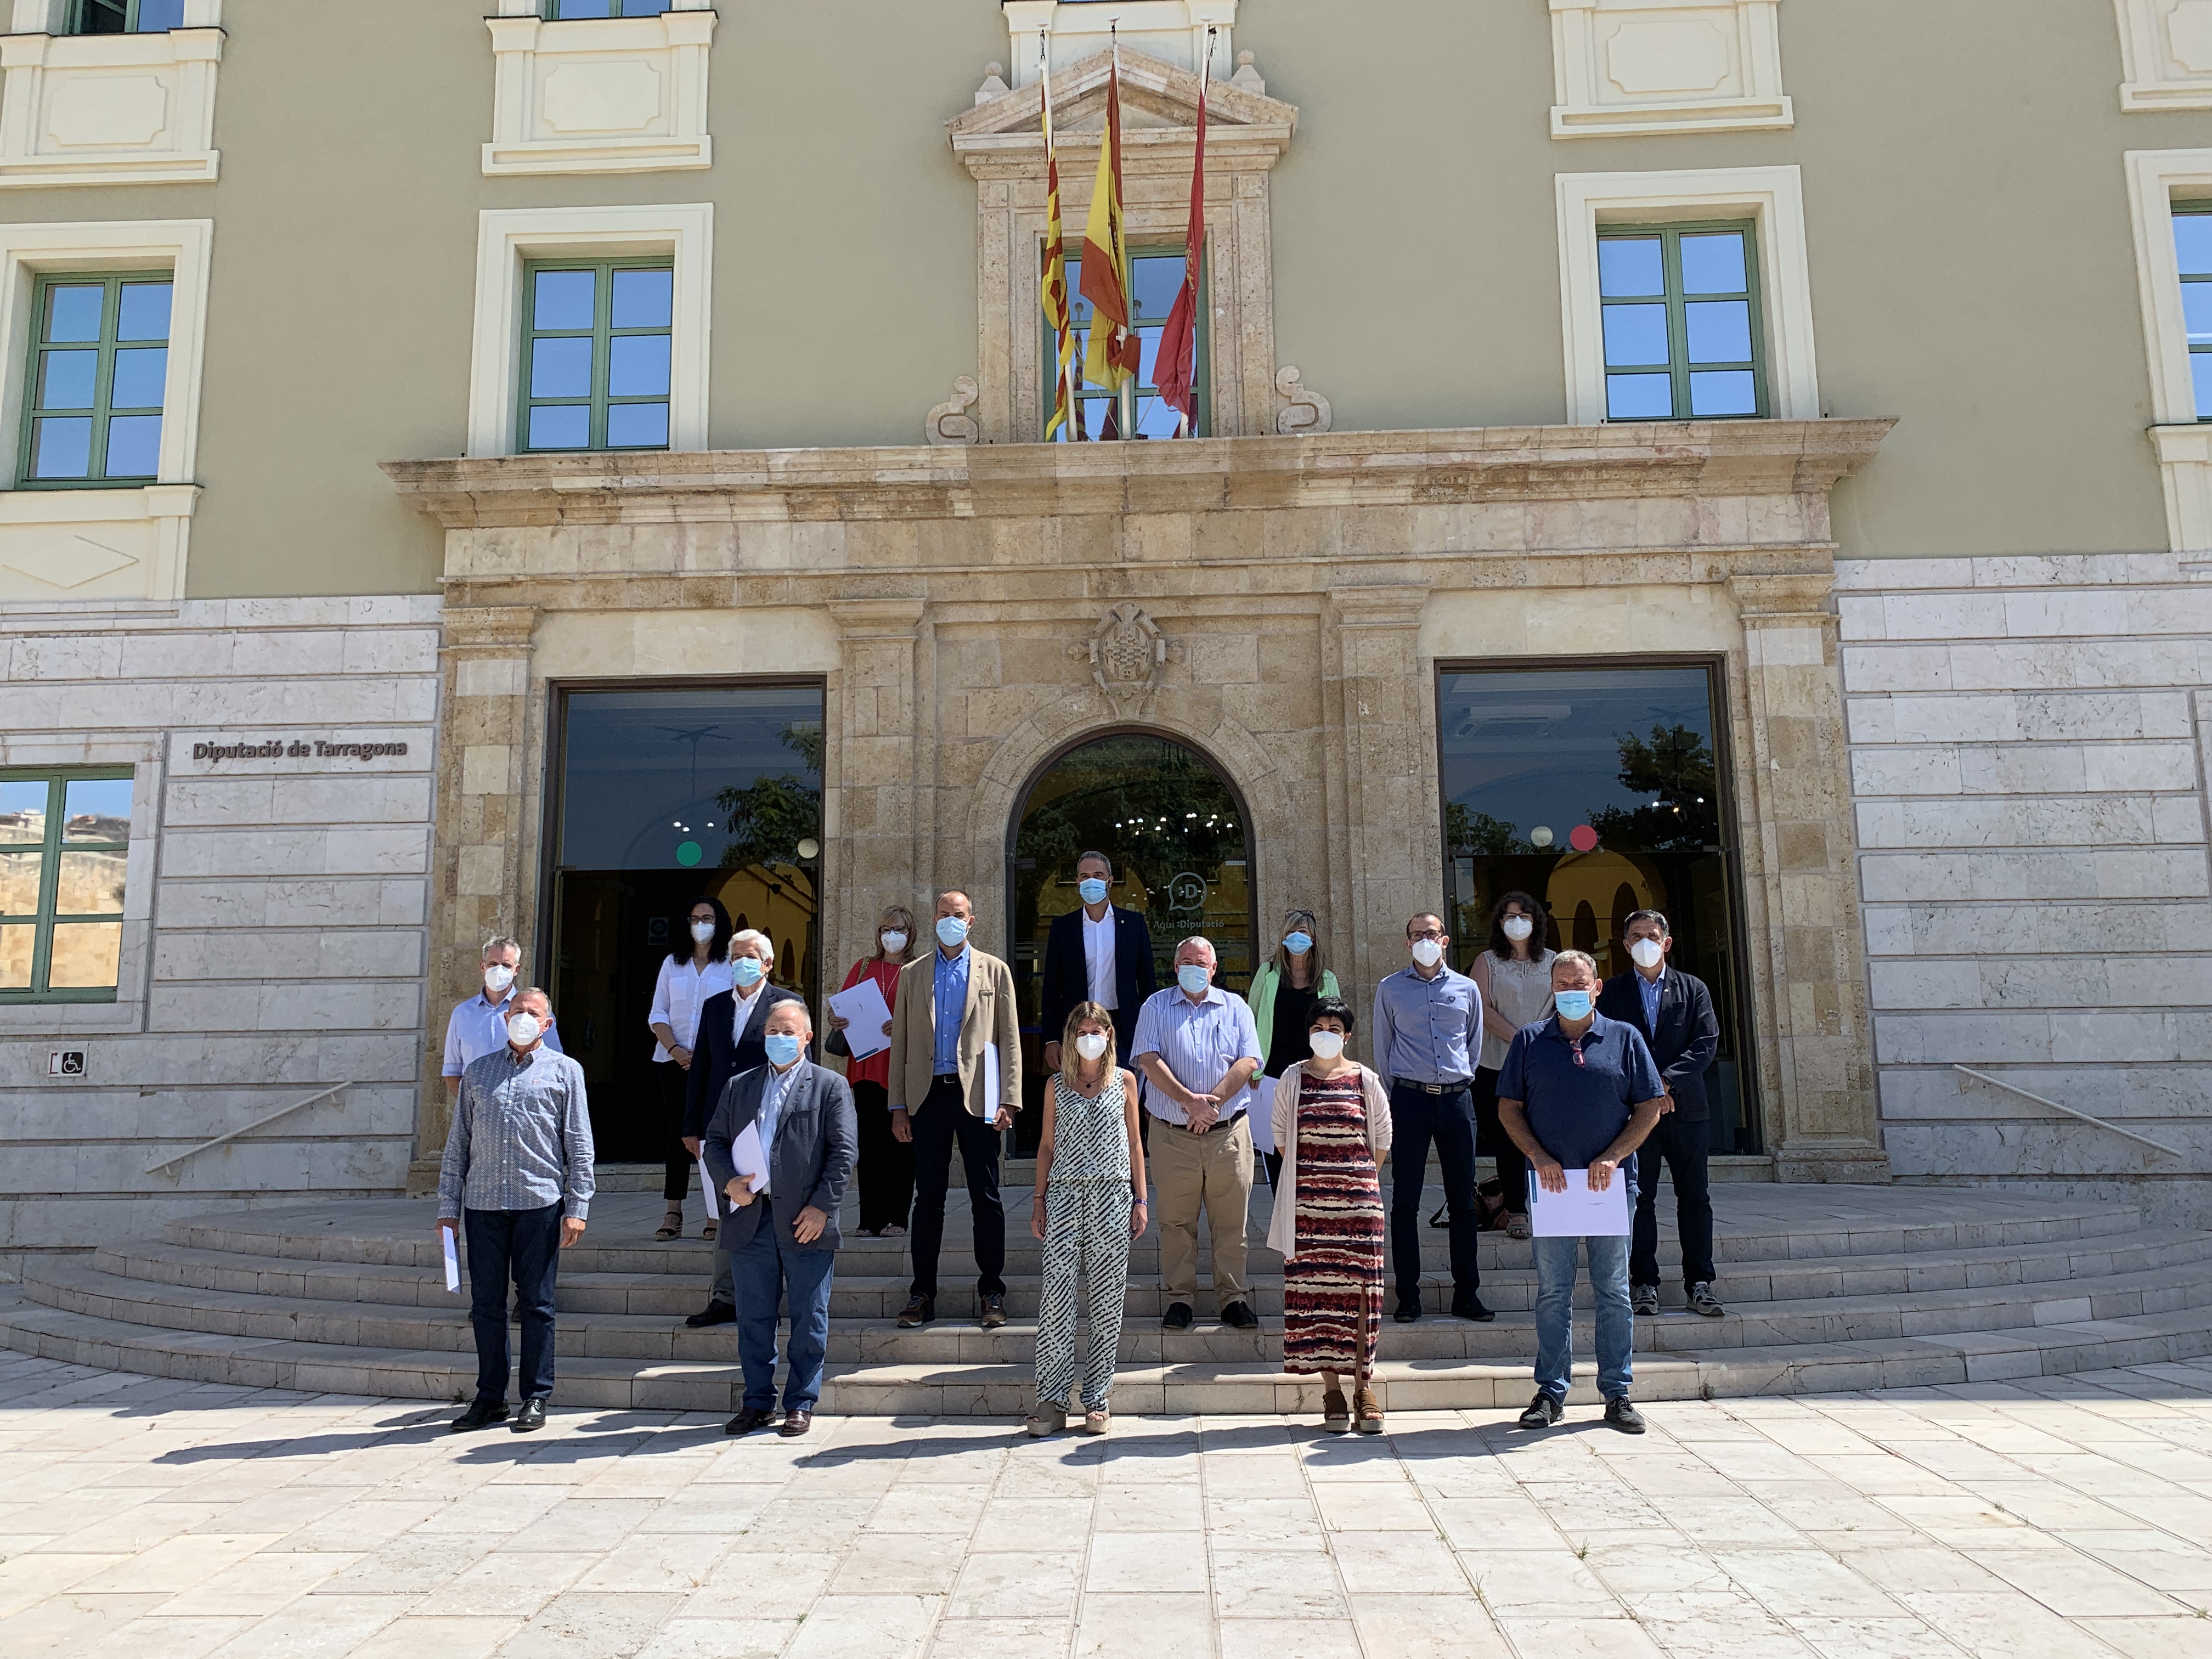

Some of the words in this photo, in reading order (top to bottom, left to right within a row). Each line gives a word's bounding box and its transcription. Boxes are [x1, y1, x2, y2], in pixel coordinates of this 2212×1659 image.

[193, 741, 283, 763] Diputació
[287, 740, 311, 757] de
[314, 741, 407, 761] Tarragona
[1154, 920, 1174, 931] Aquí
